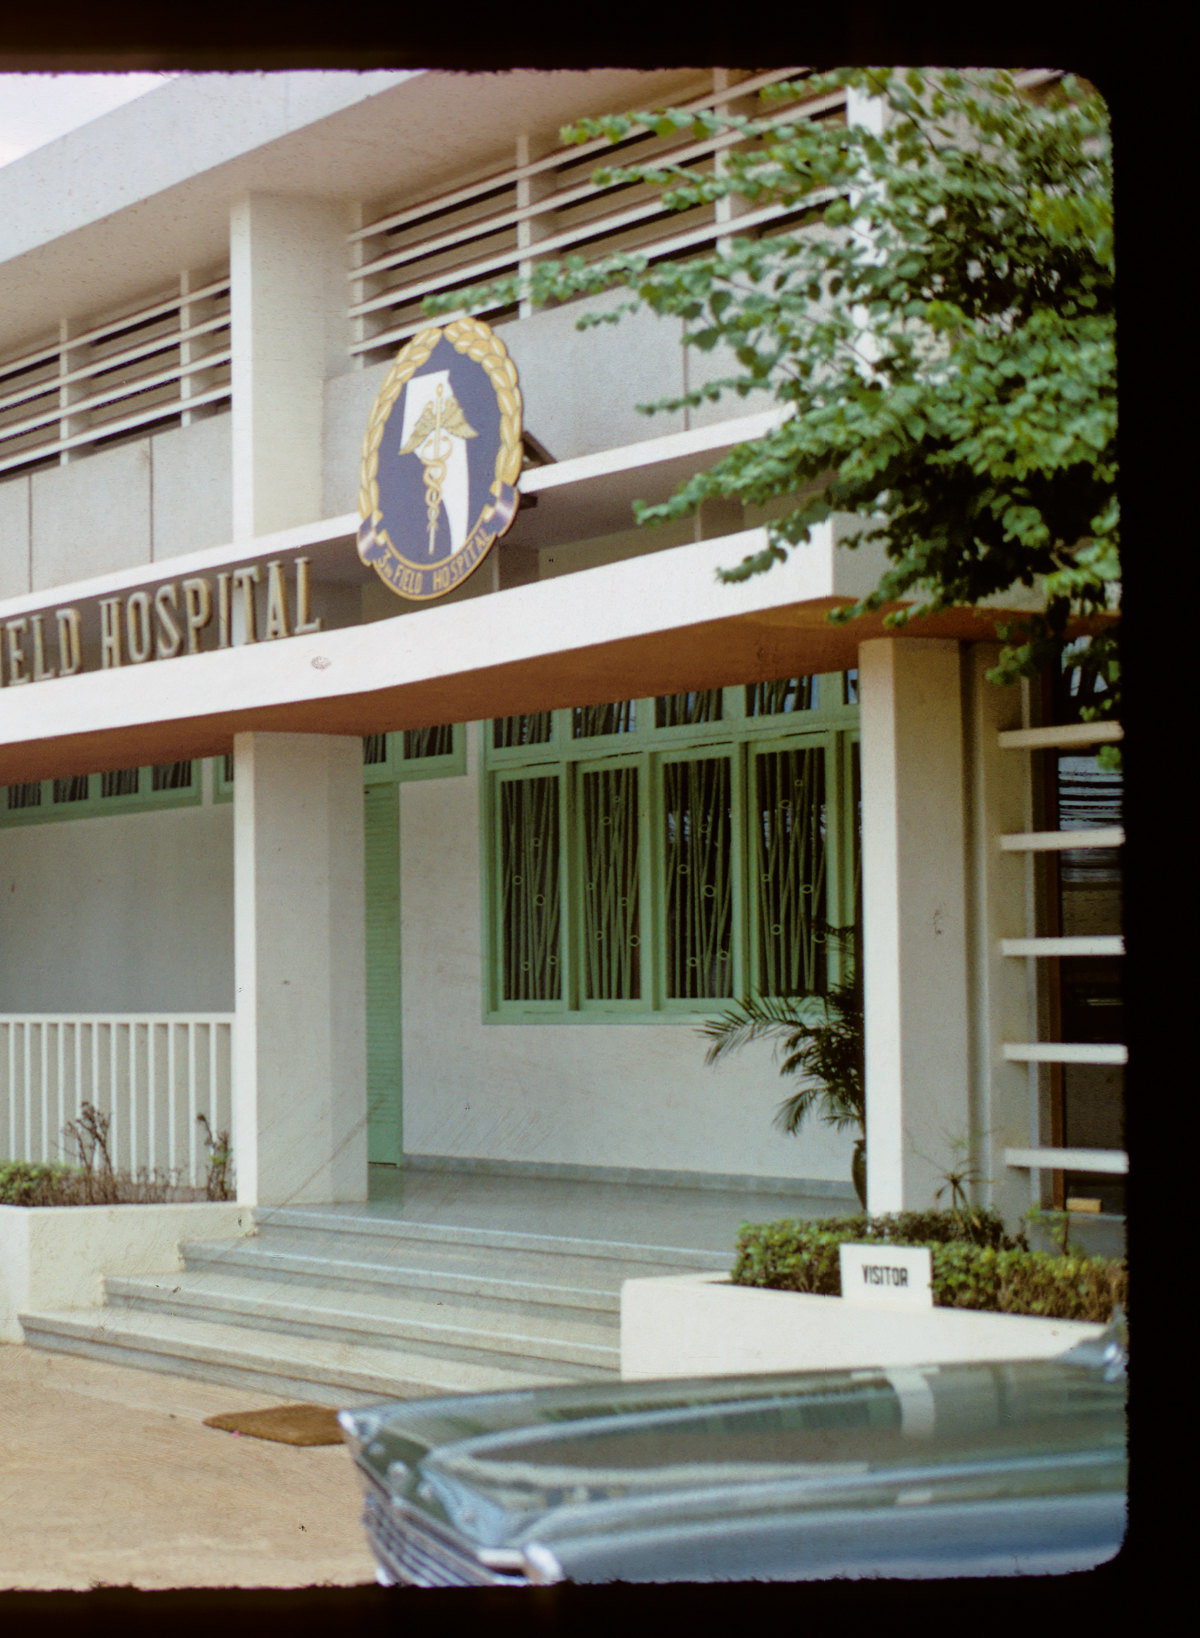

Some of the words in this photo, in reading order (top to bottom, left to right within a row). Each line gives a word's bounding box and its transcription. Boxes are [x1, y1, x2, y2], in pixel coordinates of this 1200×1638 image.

[393, 564, 424, 594] FIELD
[433, 528, 493, 591] HOSPITAL
[100, 556, 322, 669] HOSPITAL
[861, 1264, 908, 1287] VISITOR
